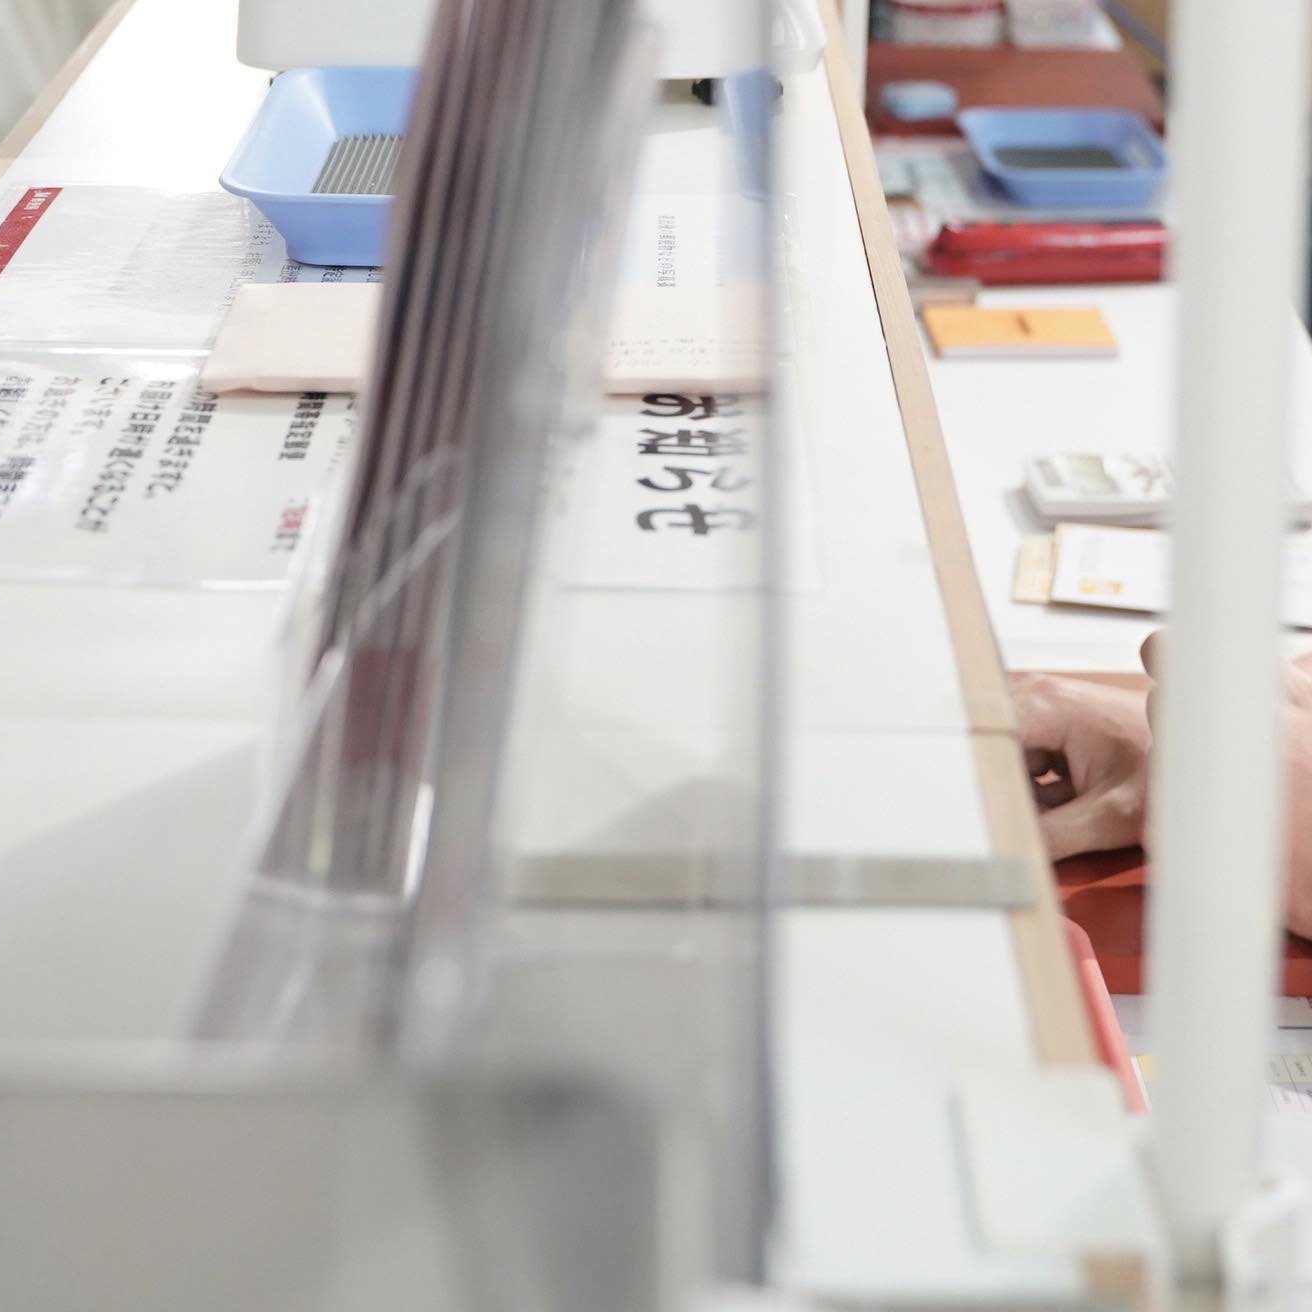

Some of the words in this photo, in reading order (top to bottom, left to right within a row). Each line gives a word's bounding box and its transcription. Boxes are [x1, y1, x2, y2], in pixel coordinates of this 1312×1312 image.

[142, 384, 219, 499] の時間を過ぎますと、
[635, 391, 728, 536] お知らせ
